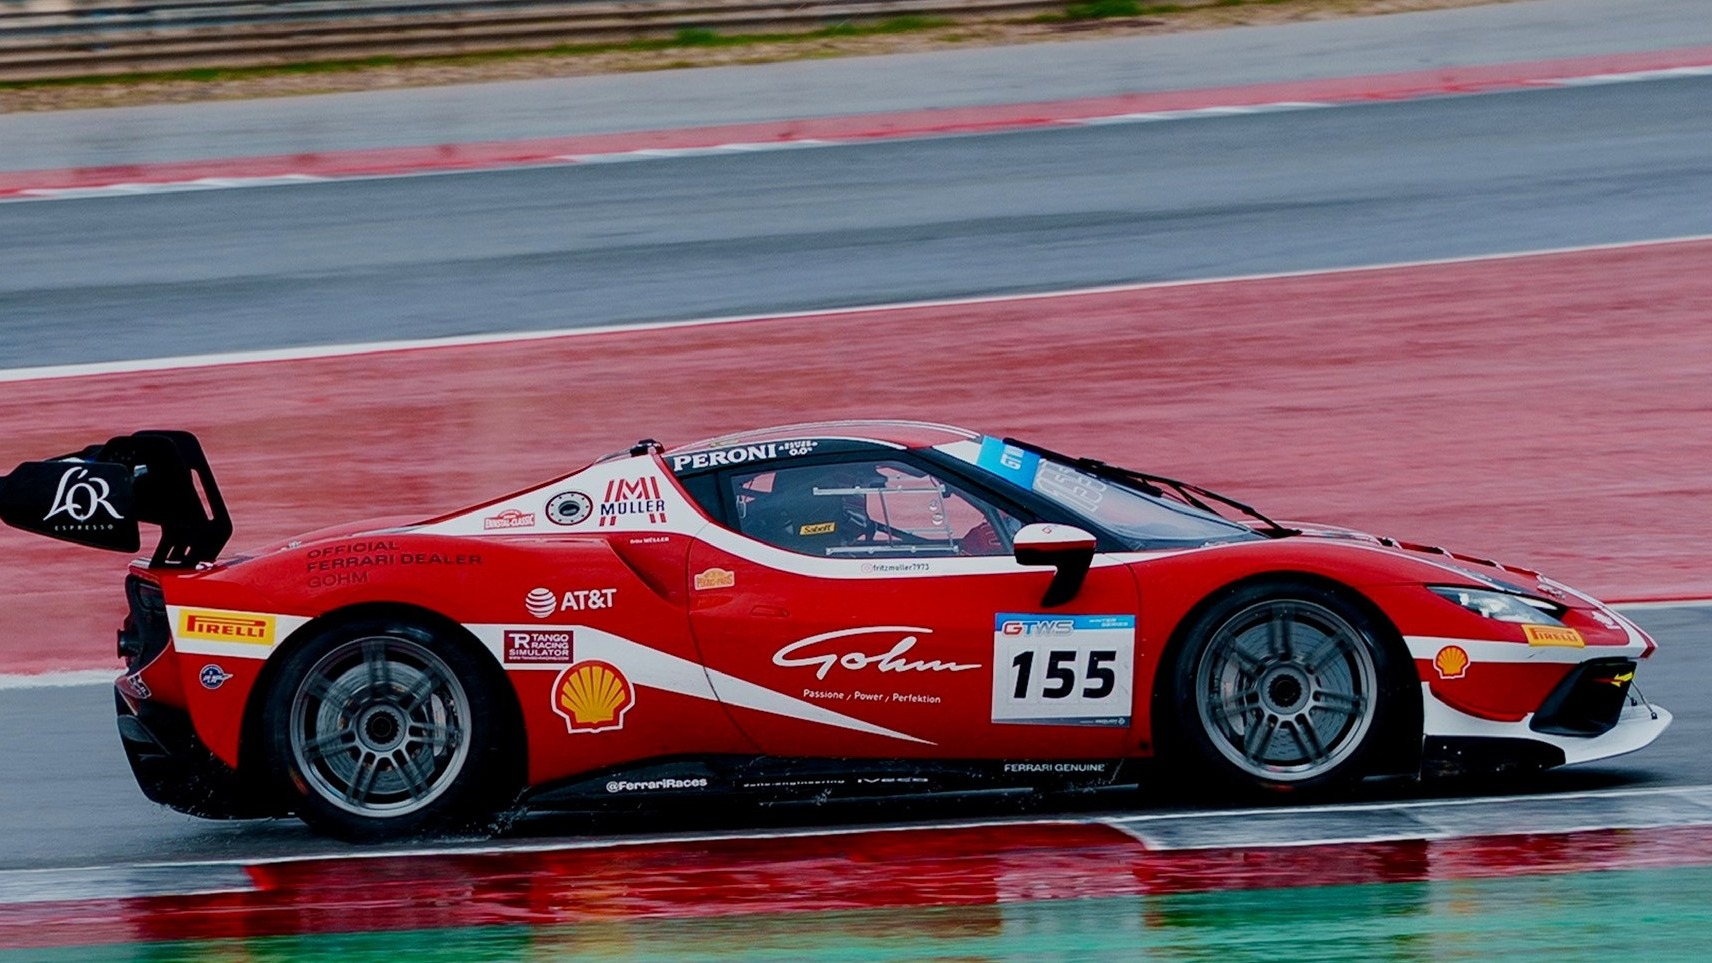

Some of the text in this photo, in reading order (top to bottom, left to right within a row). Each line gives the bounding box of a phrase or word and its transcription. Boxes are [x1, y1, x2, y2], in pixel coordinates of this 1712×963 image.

[673, 443, 776, 472] PERONI
[600, 500, 666, 516] MÜLLER
[307, 541, 399, 559] OFFICIAL
[307, 553, 482, 572] FERRARI DEALER
[560, 588, 618, 611] AT&T
[187, 615, 267, 638] PIRELLI
[1003, 621, 1073, 637] GTWS
[531, 633, 569, 642] TANGO
[1529, 627, 1578, 643] PIRELLI
[509, 649, 569, 657] SIMULATOR
[772, 625, 983, 681] Gohm
[1012, 650, 1117, 700] 155
[803, 689, 844, 700] Passione
[854, 691, 883, 701] Power
[892, 692, 941, 704] Perfektion
[1004, 763, 1105, 772] FERRARI GENUINE
[606, 778, 708, 793] @FerrariRaces
